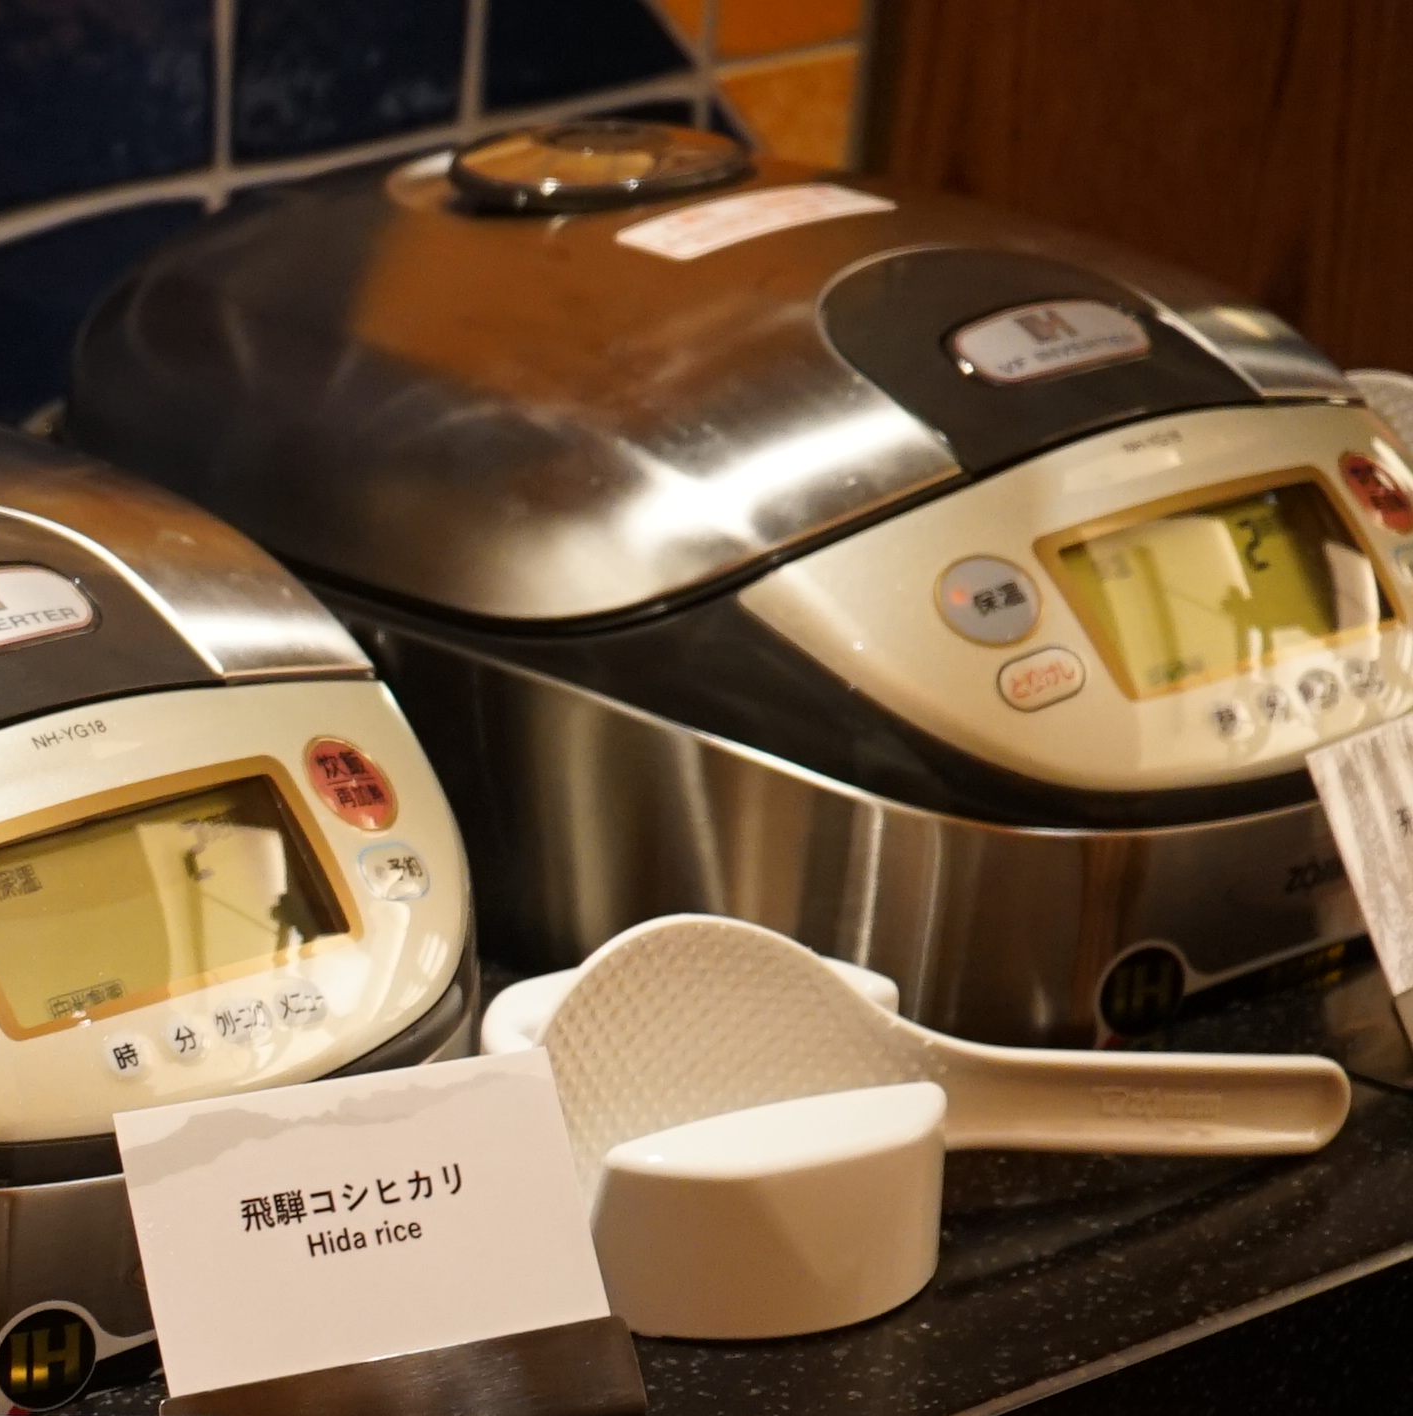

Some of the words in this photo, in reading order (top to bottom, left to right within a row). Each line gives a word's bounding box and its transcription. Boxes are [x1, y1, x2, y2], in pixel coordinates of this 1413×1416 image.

[32, 719, 108, 751] NH-YG18
[112, 1043, 139, 1070] 時
[175, 1026, 198, 1053] 分
[240, 1163, 462, 1232] 飛騨コシヒカリ
[307, 1228, 367, 1257] Hida
[375, 1220, 423, 1245] rice
[9, 1321, 83, 1394] IH
